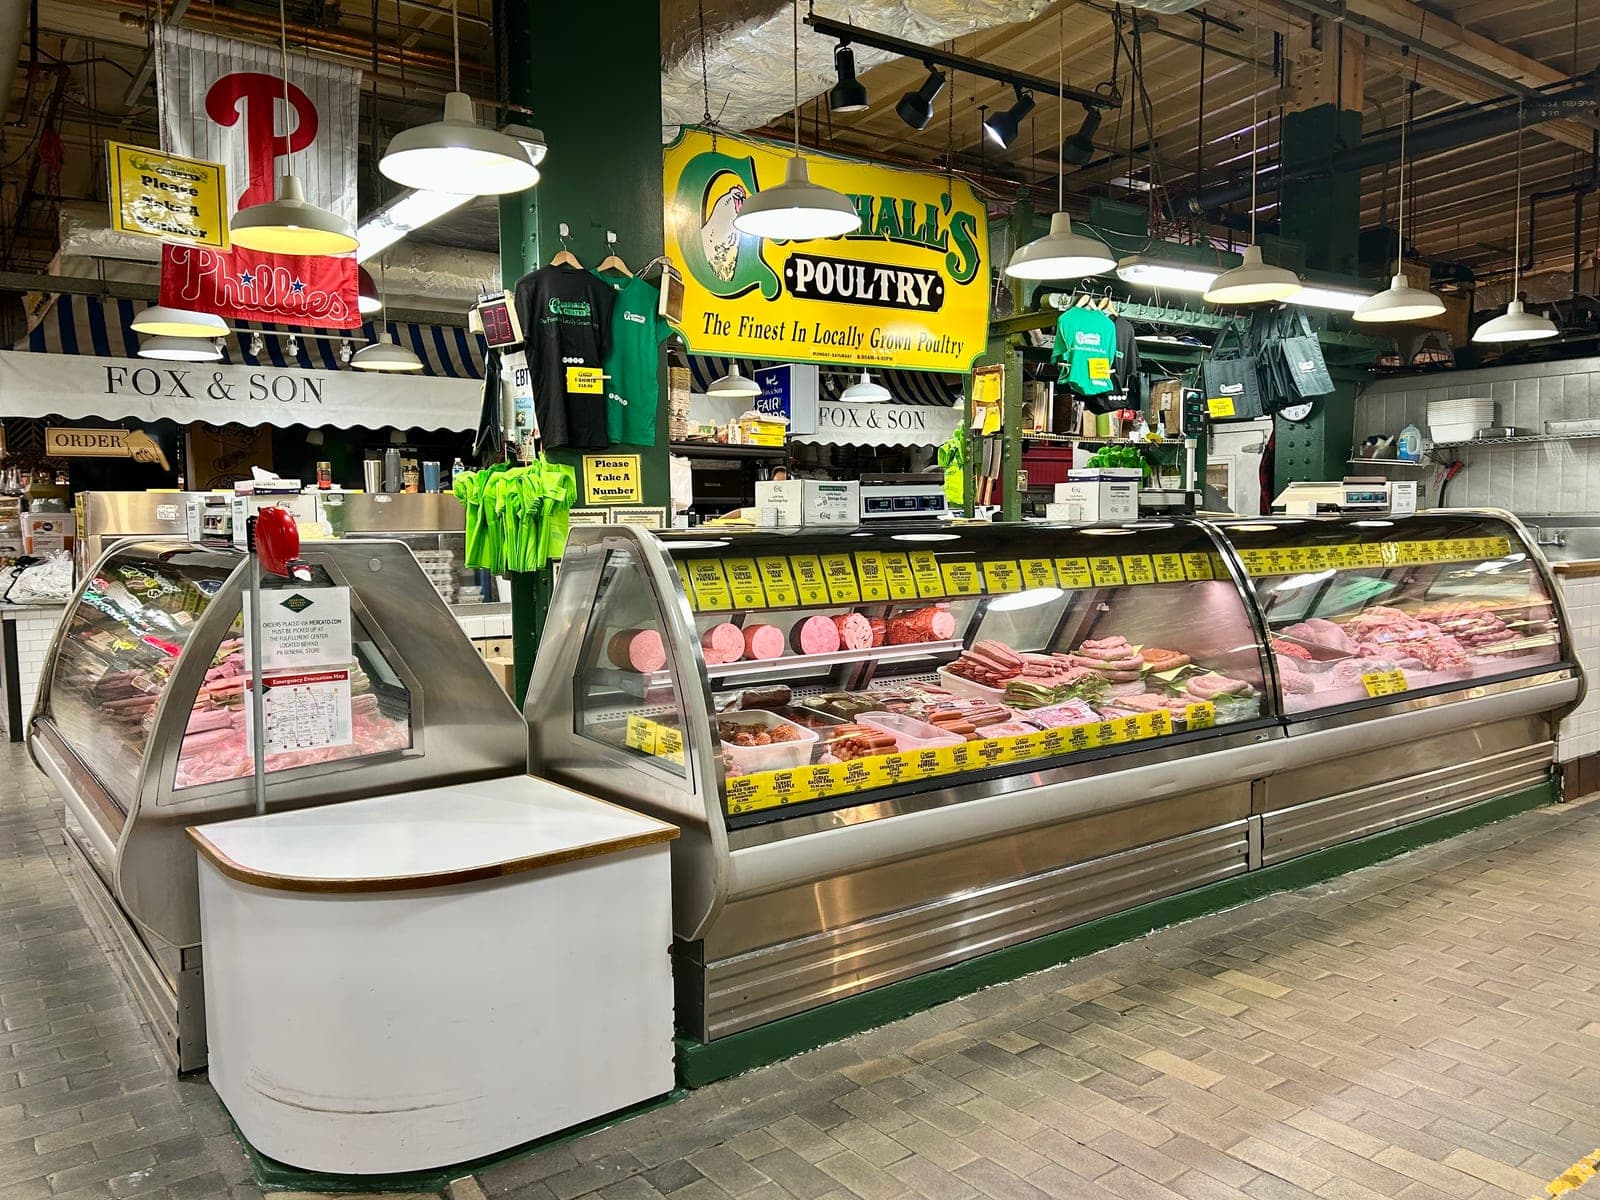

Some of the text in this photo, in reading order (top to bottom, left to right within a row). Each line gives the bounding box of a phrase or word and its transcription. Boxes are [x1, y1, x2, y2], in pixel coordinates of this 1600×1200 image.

[190, 205, 200, 217] A
[676, 151, 981, 301] GHALL'S
[170, 245, 350, 322] Phillies
[795, 258, 937, 306] POULTRY
[703, 312, 964, 358] The Finest In Locally Grown Poultry
[103, 365, 325, 404] FOX & SON
[515, 368, 530, 387] EBT
[757, 397, 779, 411] FAIR
[819, 406, 927, 430] FOX & SON
[55, 433, 123, 449] ORDER
[594, 460, 630, 468] Please
[596, 473, 630, 481] Take A
[592, 487, 635, 495] Number
[309, 618, 342, 626] MERCATO.COM
[280, 641, 300, 649] LOCATED
[272, 677, 303, 686] Emergency
